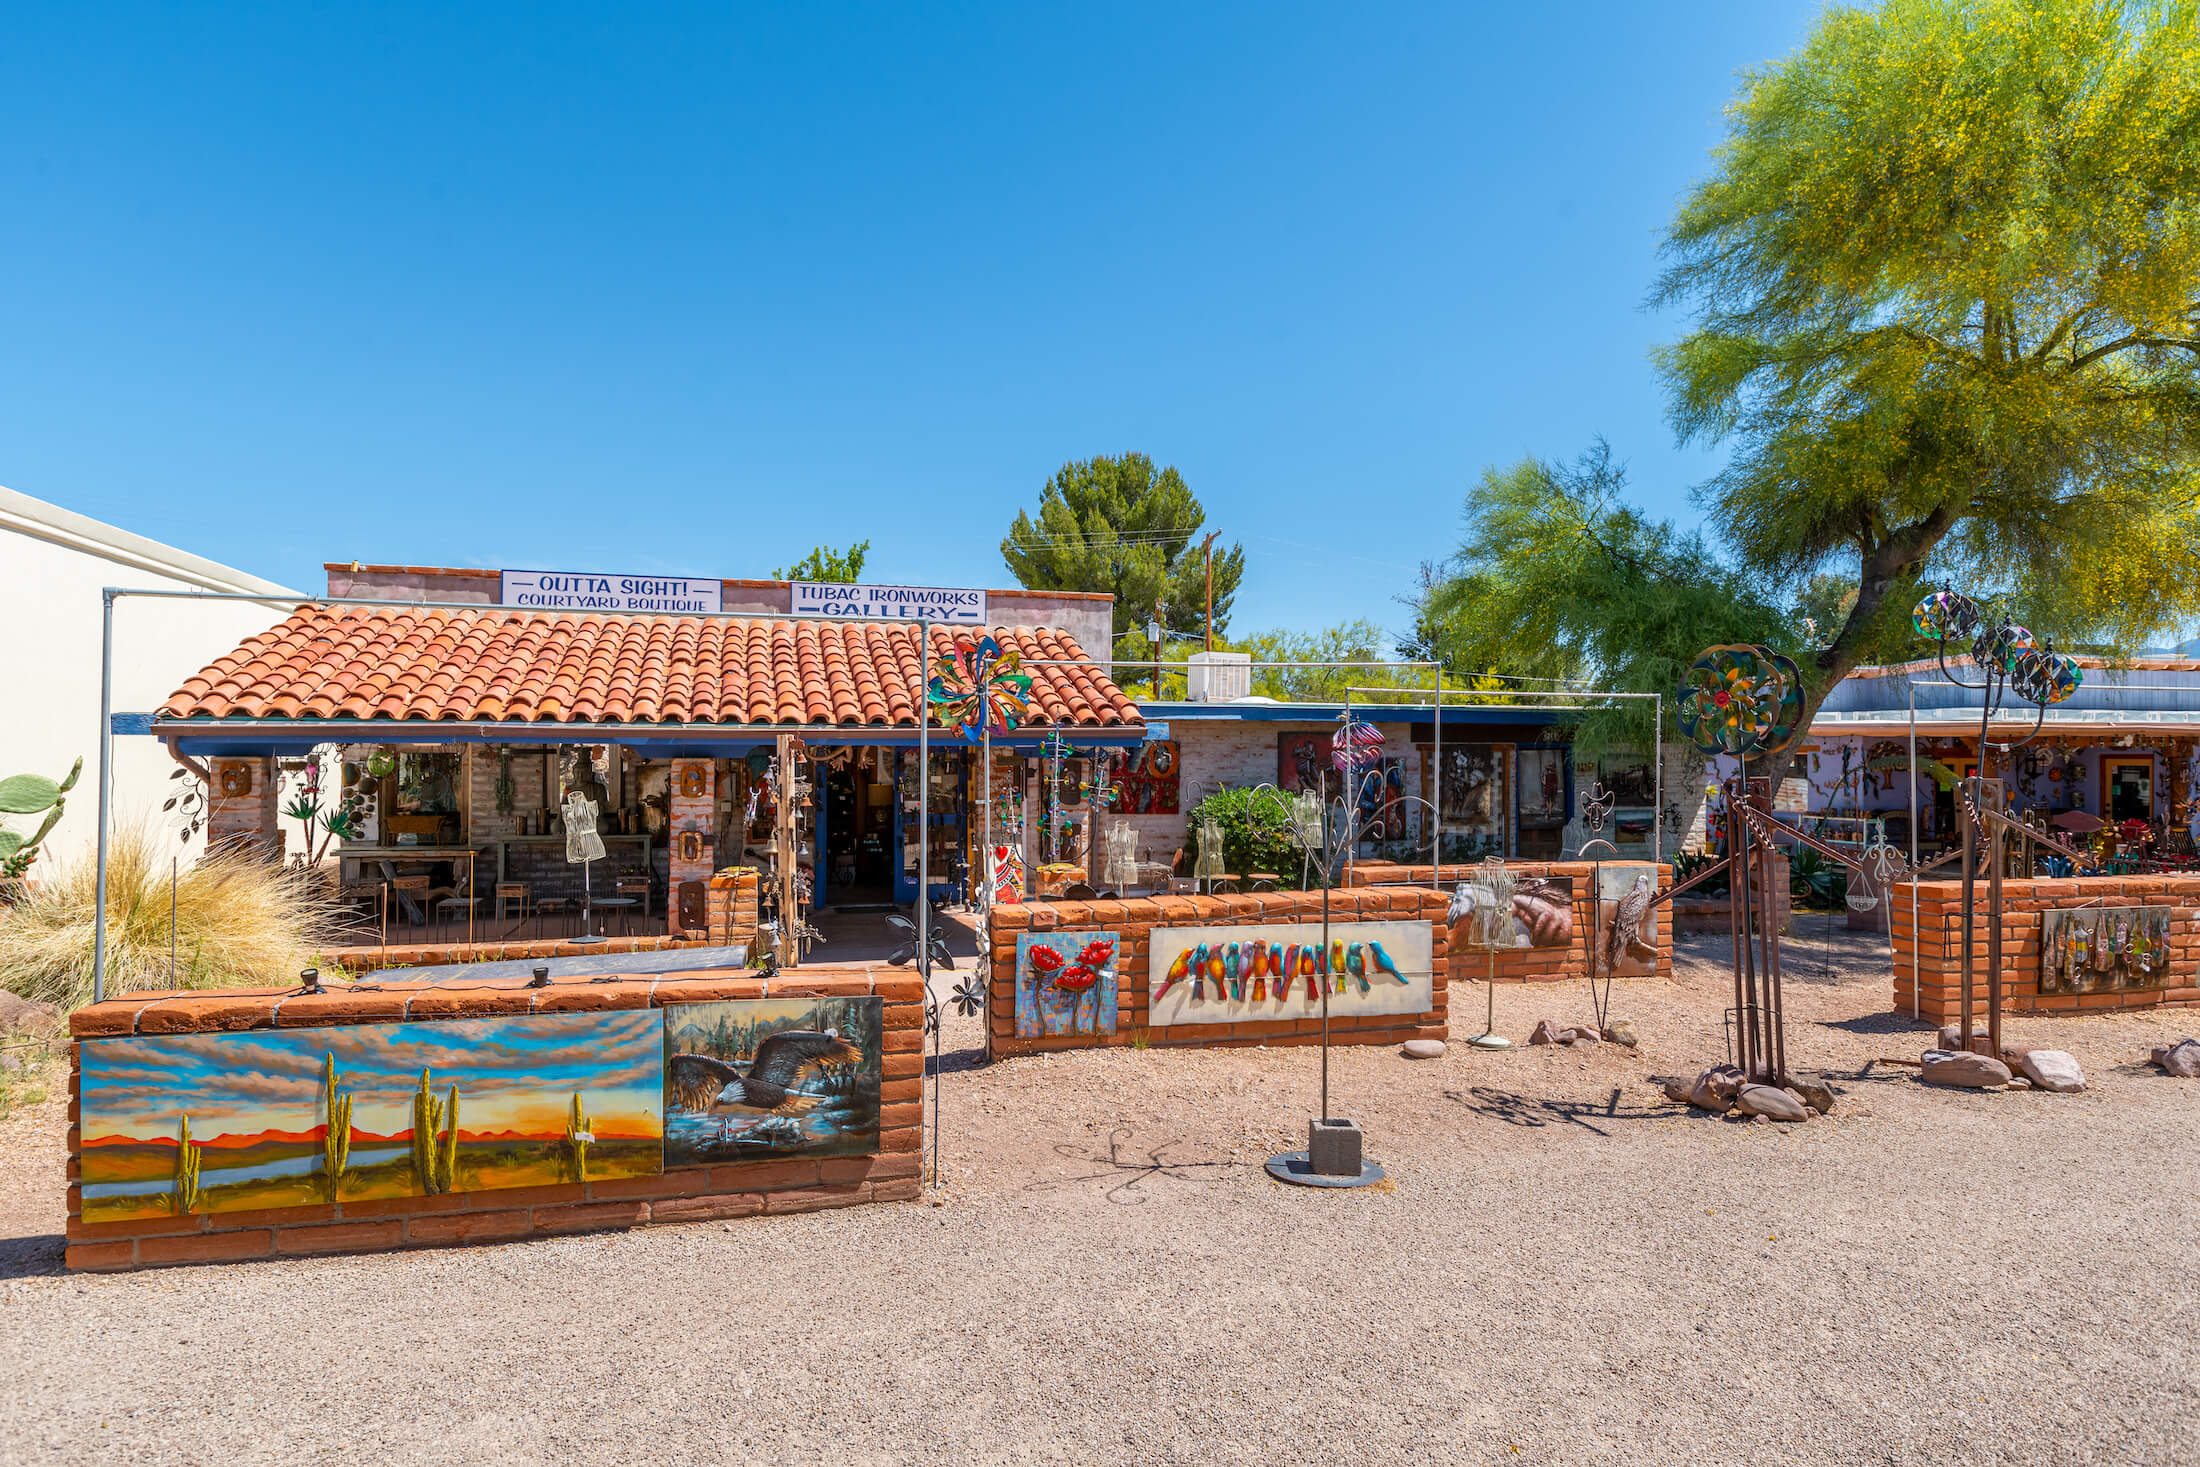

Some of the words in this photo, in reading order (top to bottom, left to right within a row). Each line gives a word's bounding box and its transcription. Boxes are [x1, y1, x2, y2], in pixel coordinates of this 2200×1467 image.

[539, 576, 611, 593] OUTTA
[620, 579, 688, 596] SIGHT!
[799, 586, 861, 600] TUBAC
[869, 589, 979, 605] IRONWORKS
[518, 593, 620, 608] COURTYARD
[628, 597, 707, 612] BOUTIQUE
[822, 602, 957, 619] GALLERY
